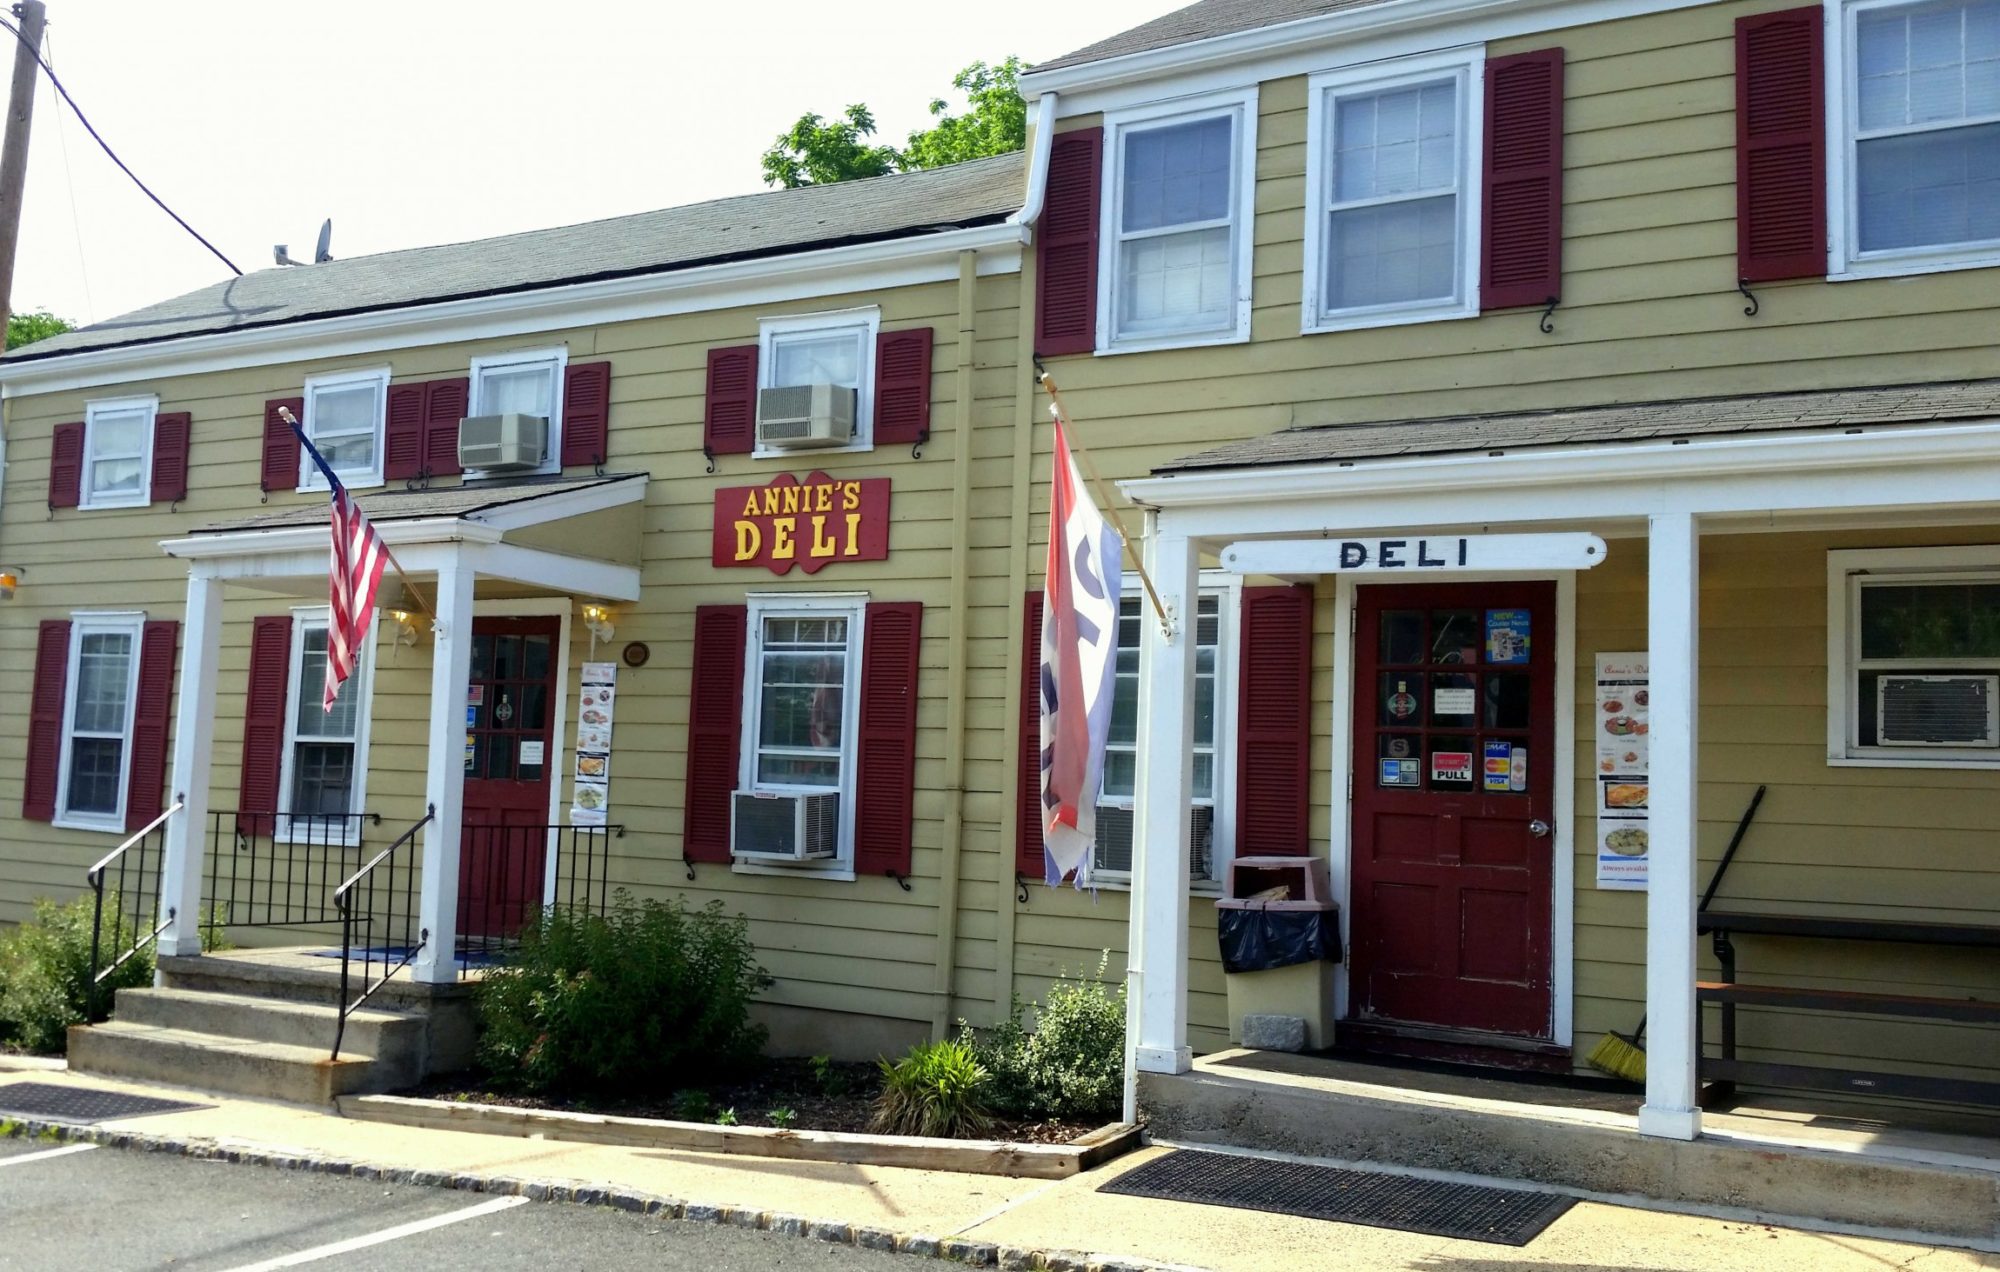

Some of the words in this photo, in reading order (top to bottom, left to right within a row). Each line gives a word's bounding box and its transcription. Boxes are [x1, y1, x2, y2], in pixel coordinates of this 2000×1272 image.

[743, 481, 861, 516] ANNIE'S
[734, 513, 861, 561] DELI
[1340, 538, 1467, 569] DELI
[1437, 770, 1468, 780] PULL
